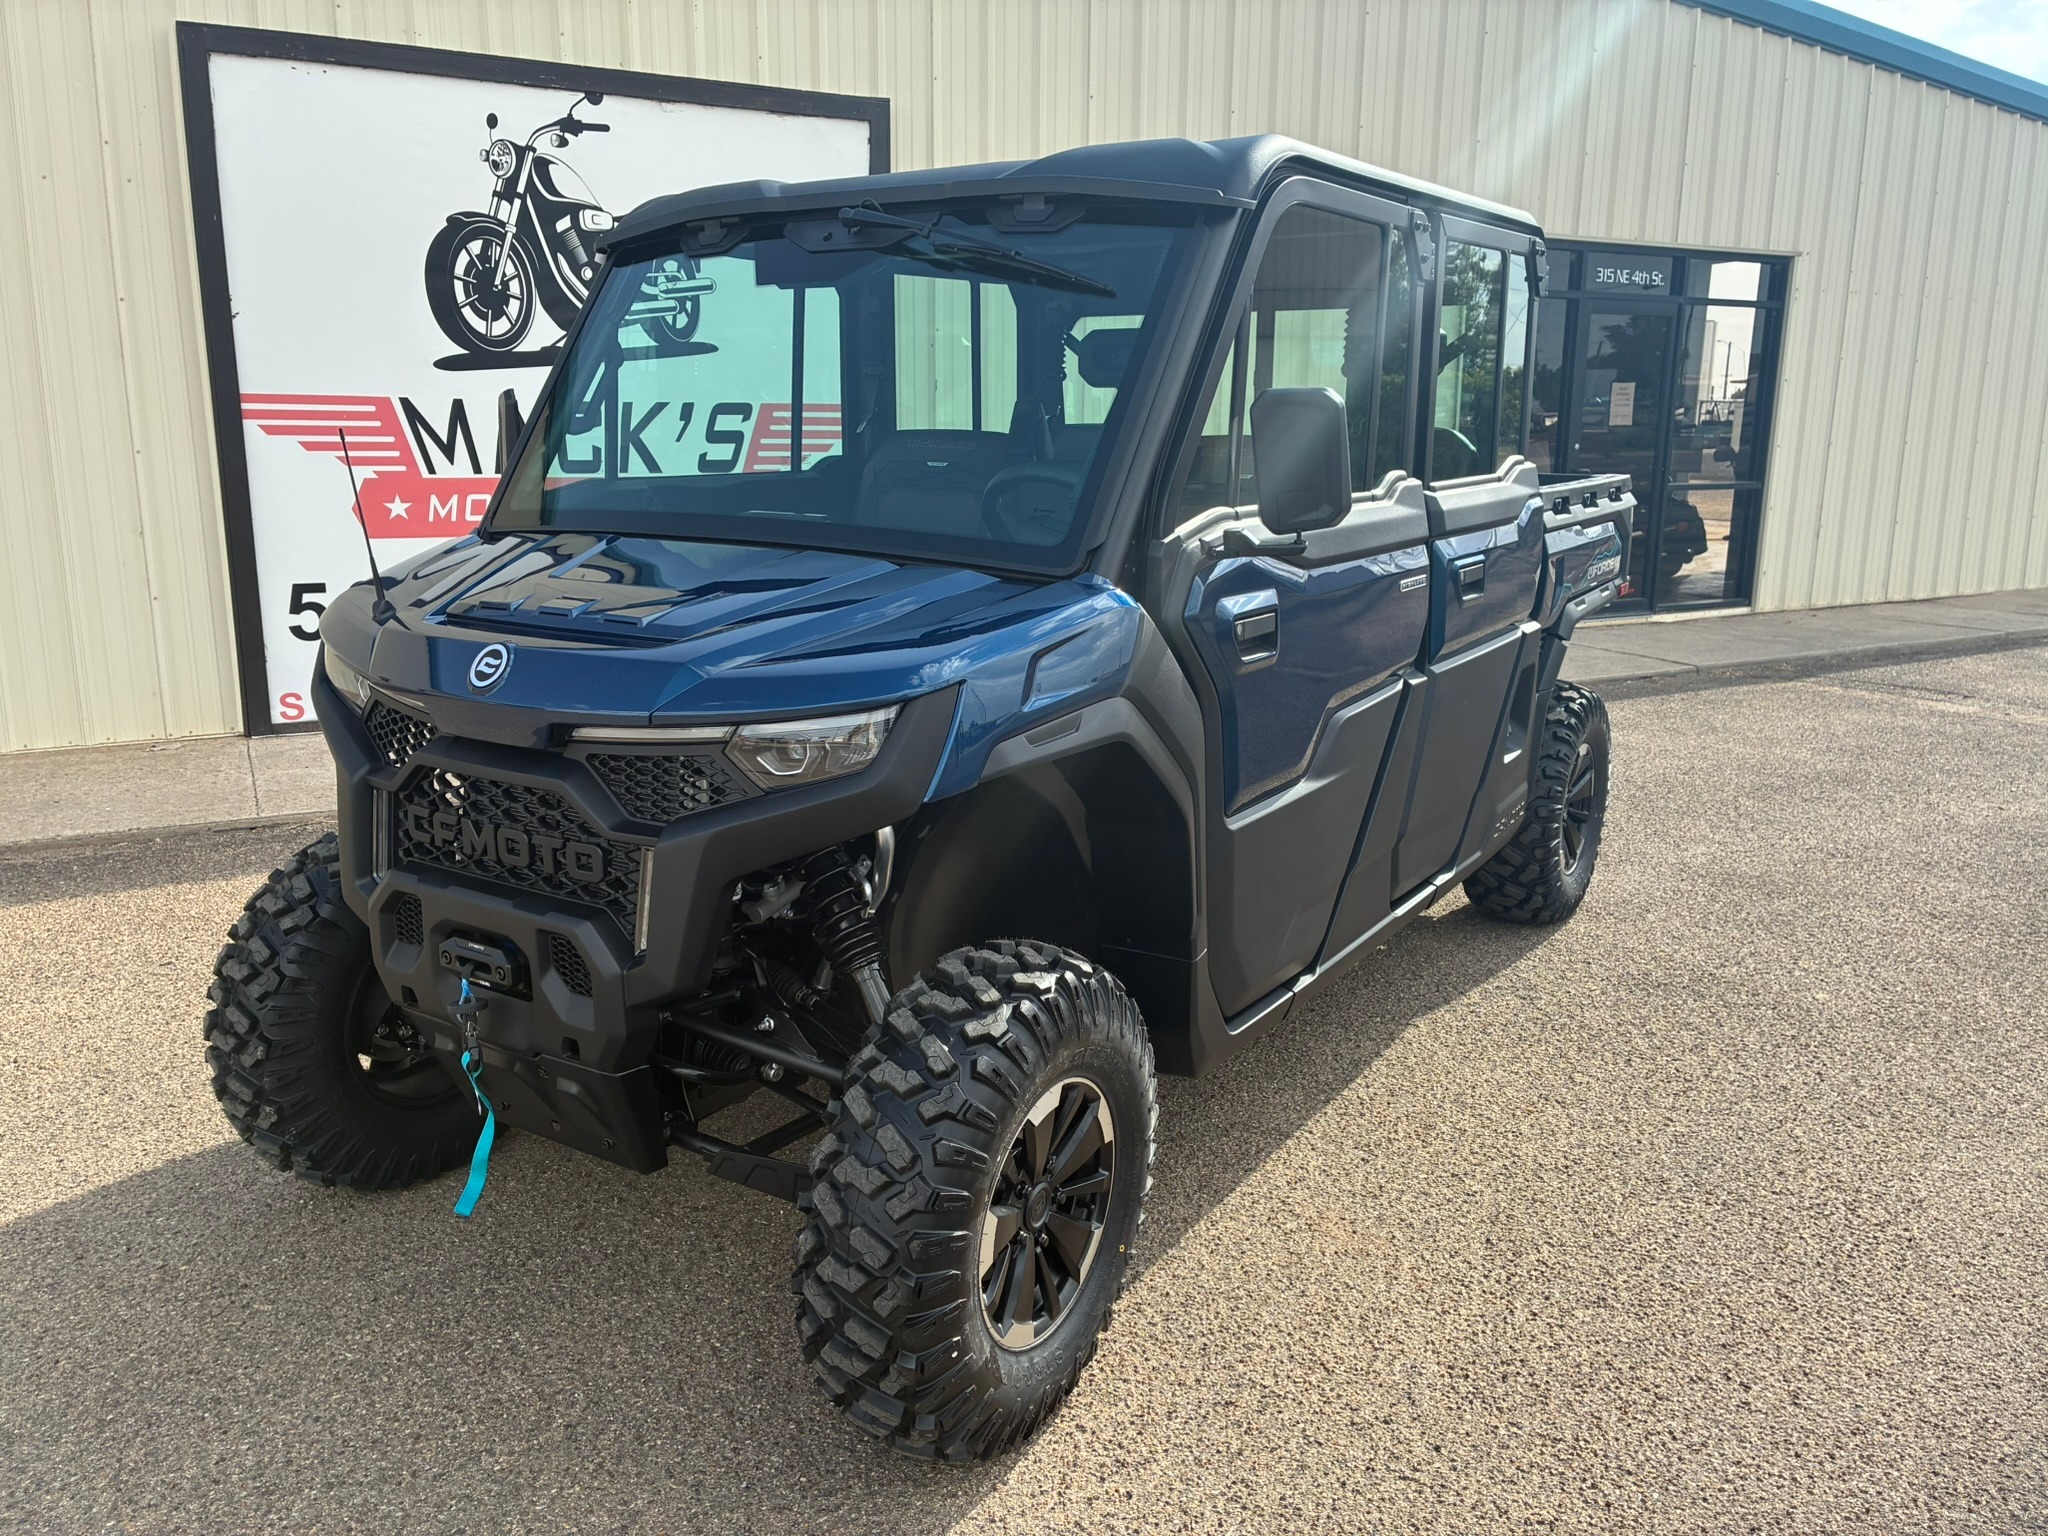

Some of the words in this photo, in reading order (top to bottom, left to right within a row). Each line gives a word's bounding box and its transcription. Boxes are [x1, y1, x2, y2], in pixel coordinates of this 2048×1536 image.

[1595, 267, 1615, 283] 315
[1616, 269, 1630, 284] NE
[1631, 270, 1650, 285] 4th
[279, 692, 305, 721] S
[407, 804, 605, 883] CFMOTO
